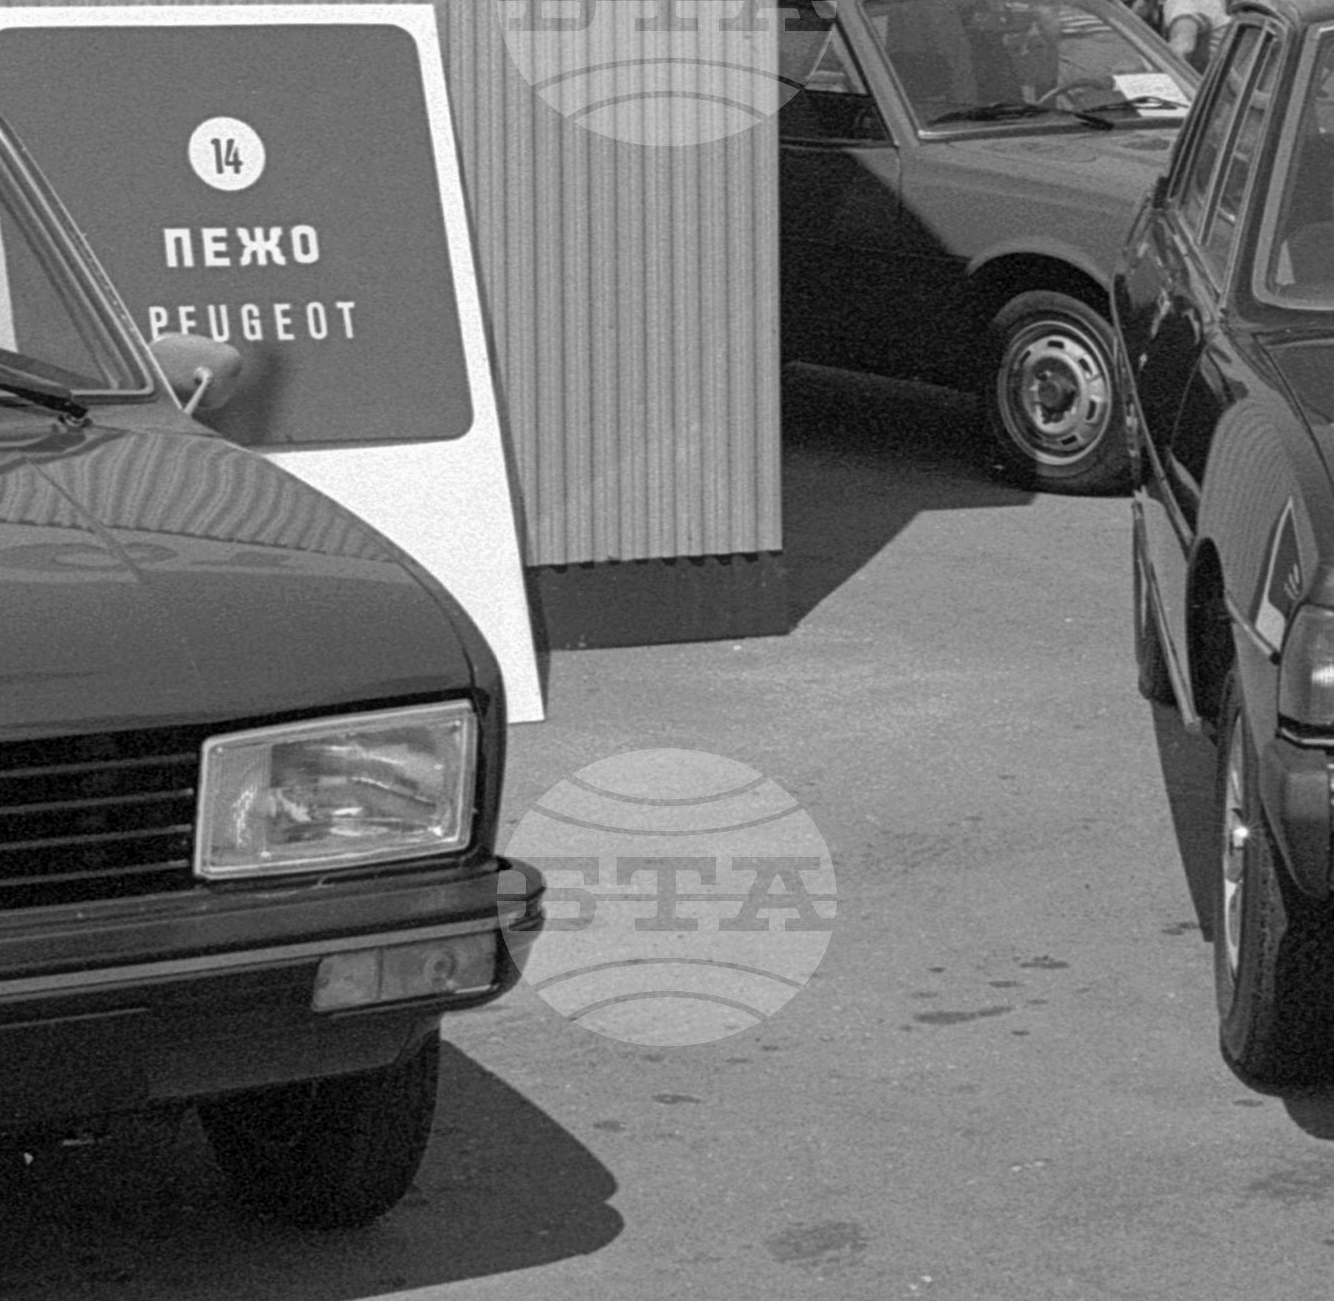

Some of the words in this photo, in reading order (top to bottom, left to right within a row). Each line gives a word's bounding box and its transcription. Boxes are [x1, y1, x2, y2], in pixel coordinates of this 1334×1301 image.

[210, 137, 244, 175] 14
[163, 224, 320, 268] ПЕЖО
[148, 301, 356, 343] PEUGEOT
